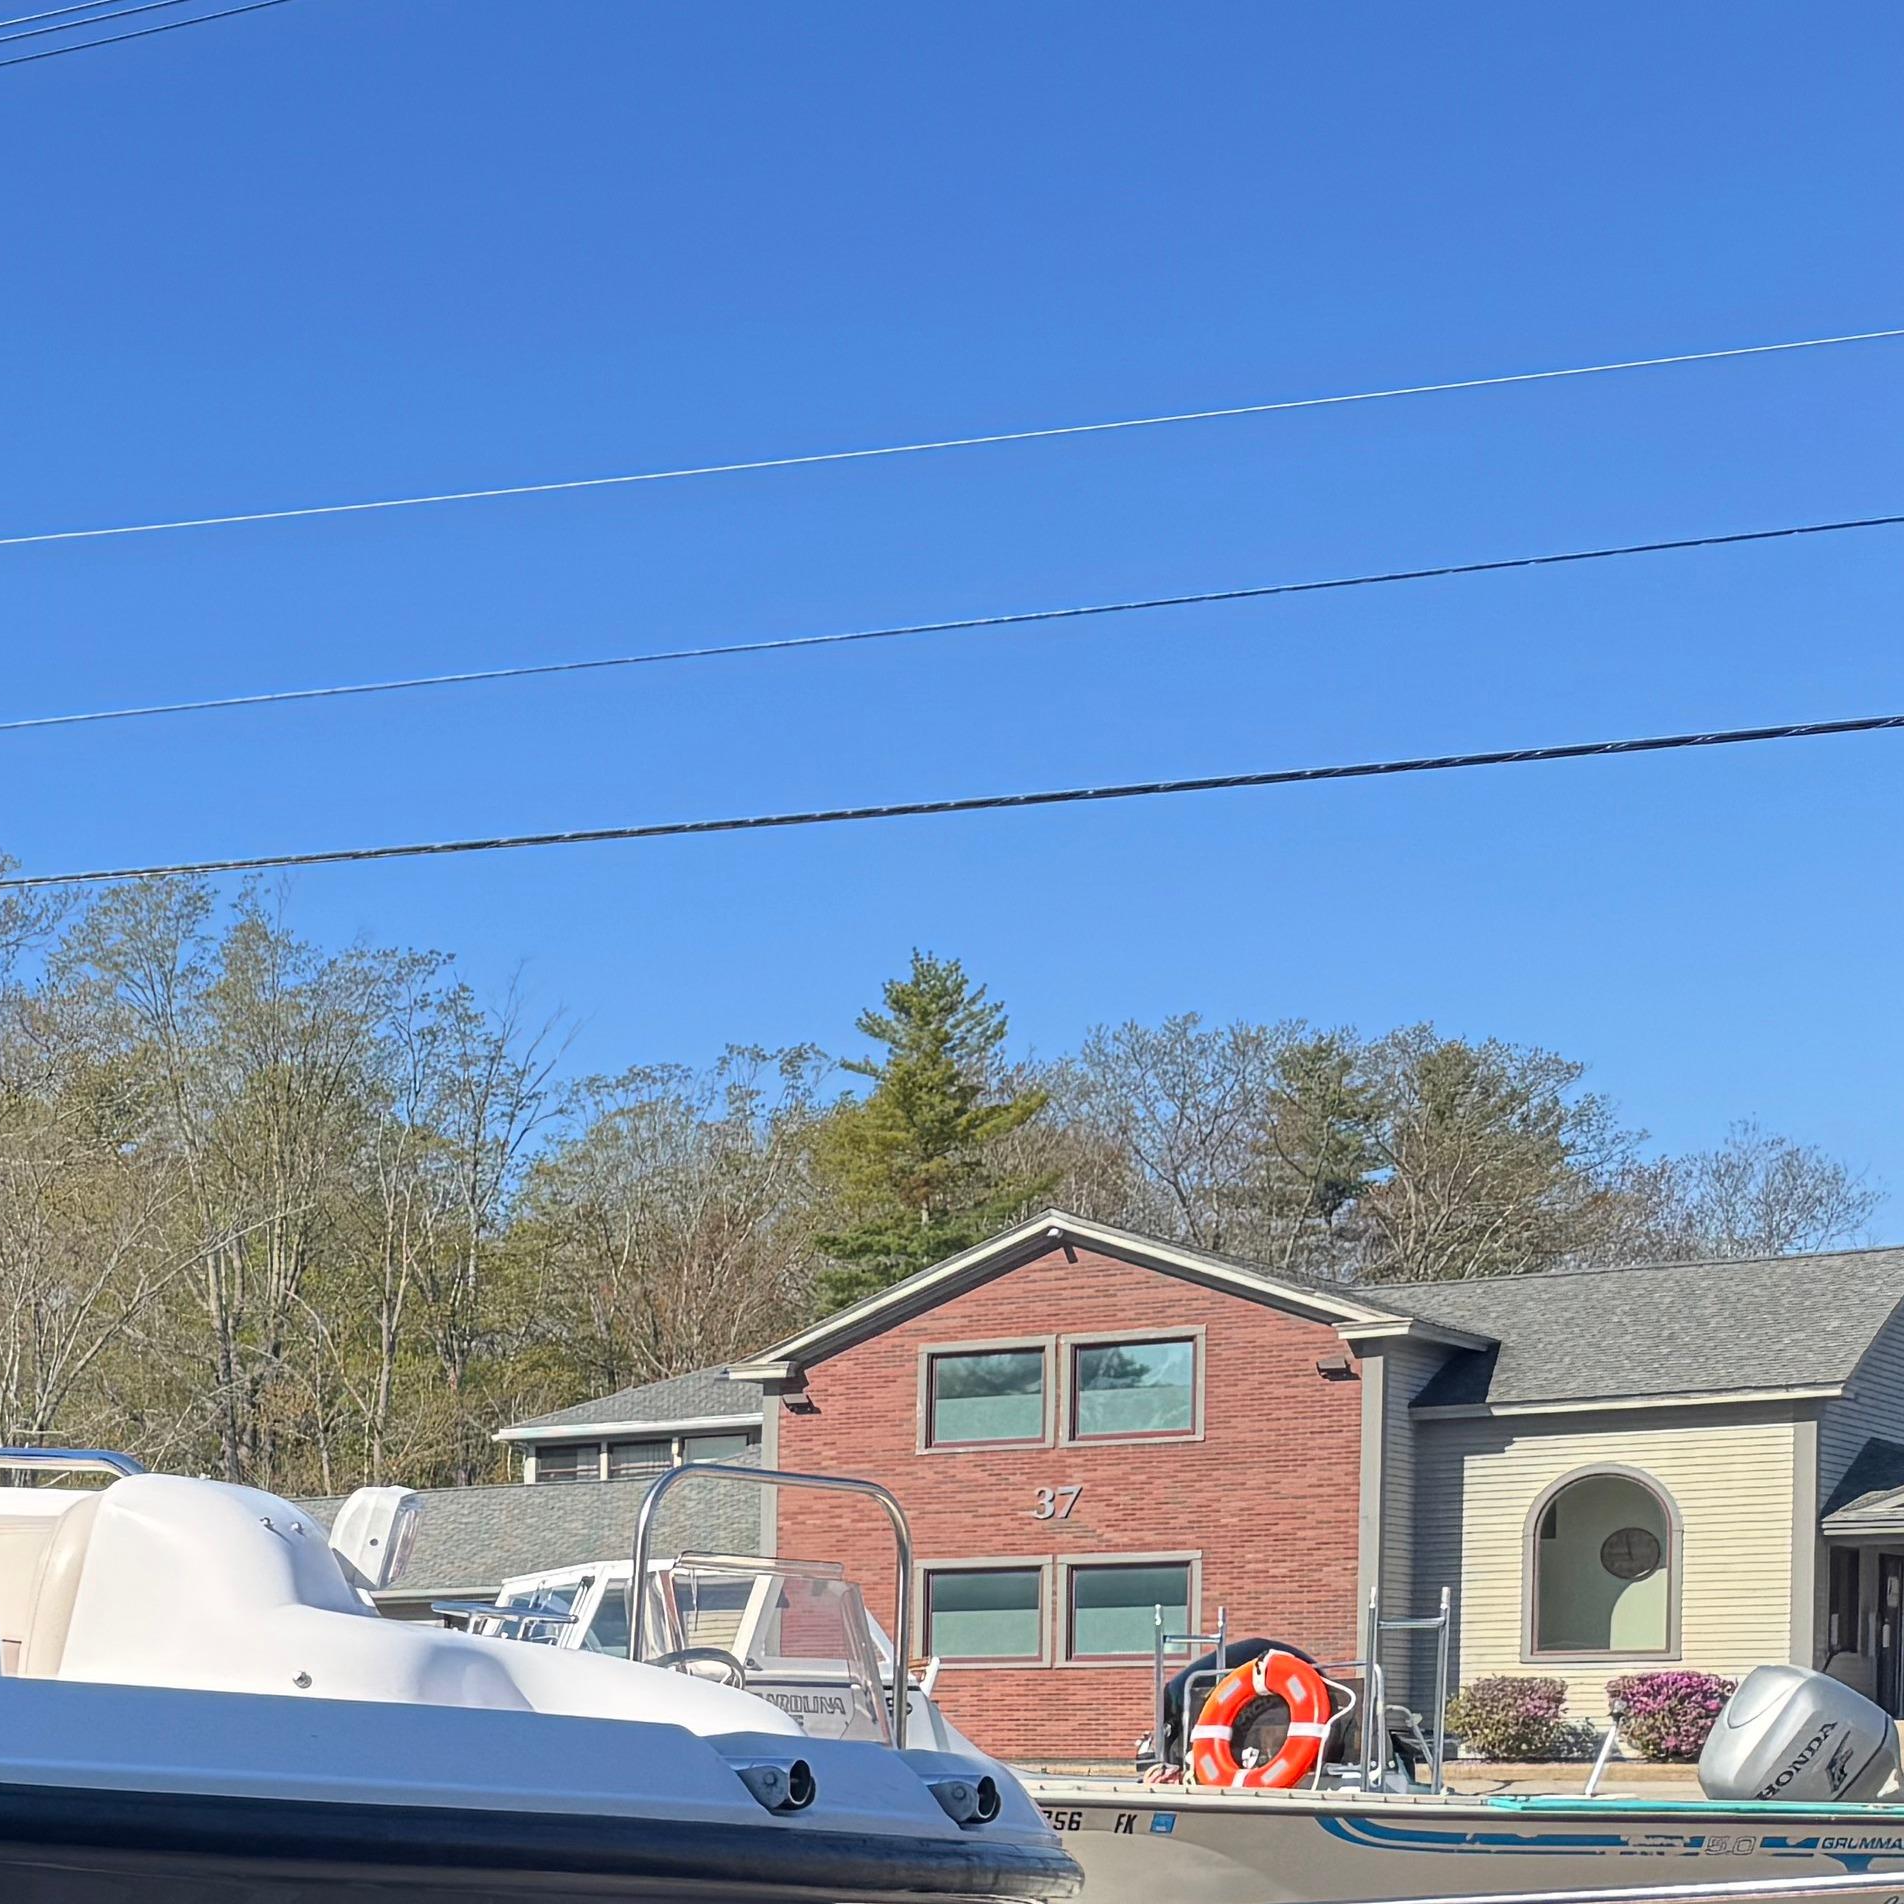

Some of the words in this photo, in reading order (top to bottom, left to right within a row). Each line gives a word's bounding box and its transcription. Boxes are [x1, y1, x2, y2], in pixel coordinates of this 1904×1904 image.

[1032, 1484, 1083, 1520] 37
[755, 1693, 846, 1715] AROLINA
[1754, 1721, 1838, 1800] HONDA
[1114, 1813, 1138, 1835] FK
